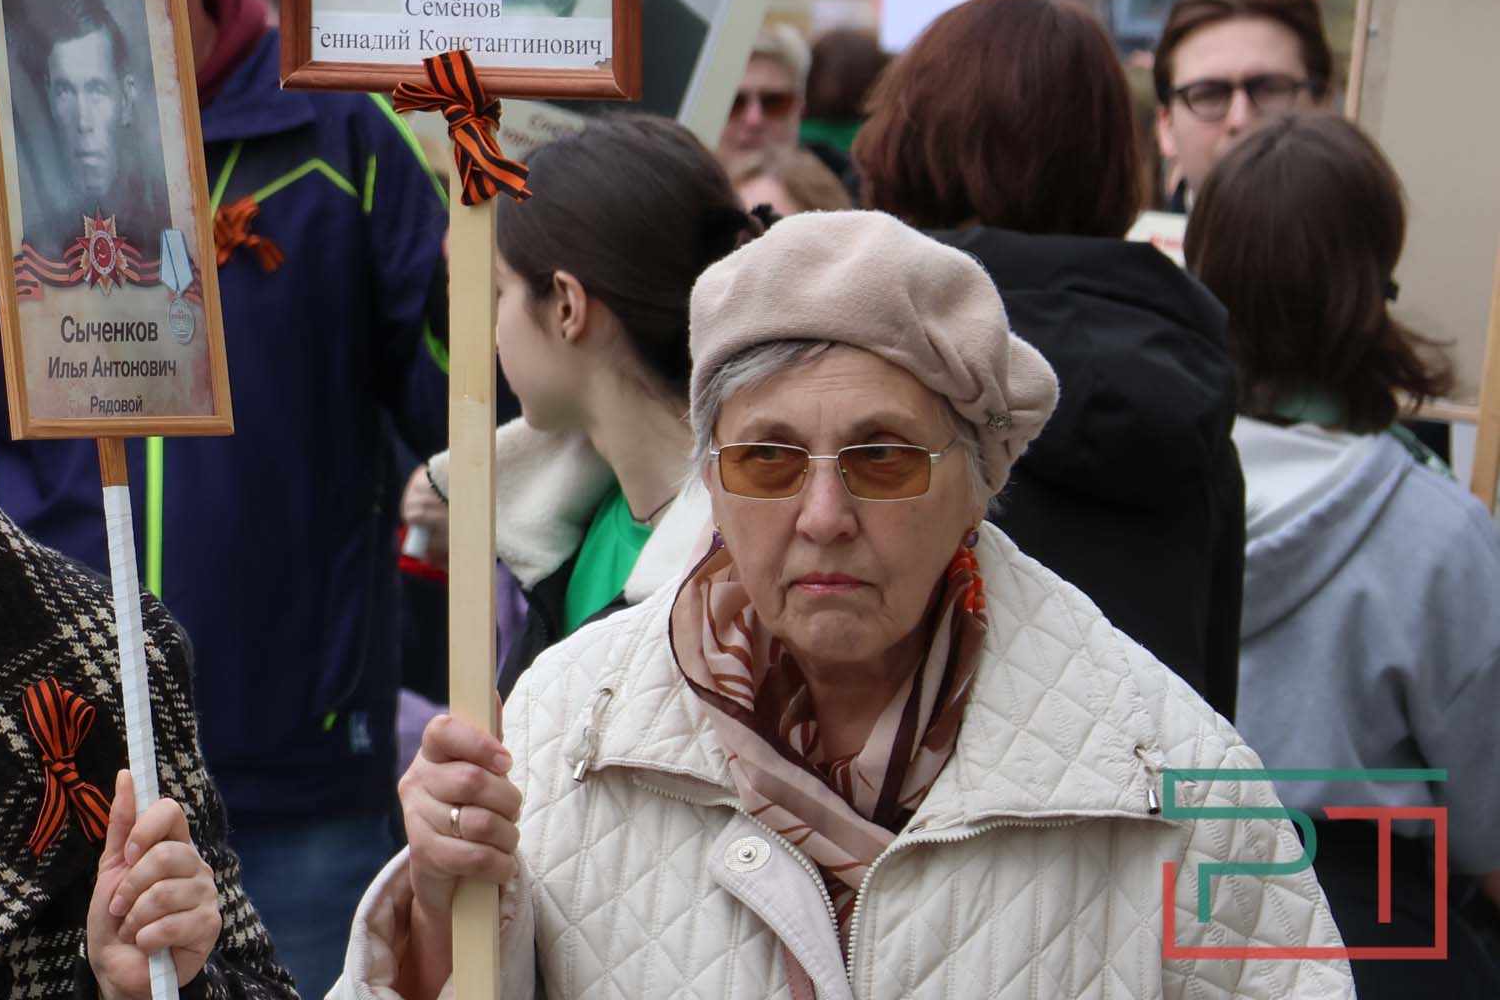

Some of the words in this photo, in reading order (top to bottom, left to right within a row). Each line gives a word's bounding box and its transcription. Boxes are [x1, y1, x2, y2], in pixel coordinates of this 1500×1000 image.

[419, 29, 602, 56] Константинович
[60, 315, 159, 343] Сыченков
[48, 356, 88, 379] Илья
[92, 355, 177, 378] Антонович
[90, 394, 143, 416] Рядовой
